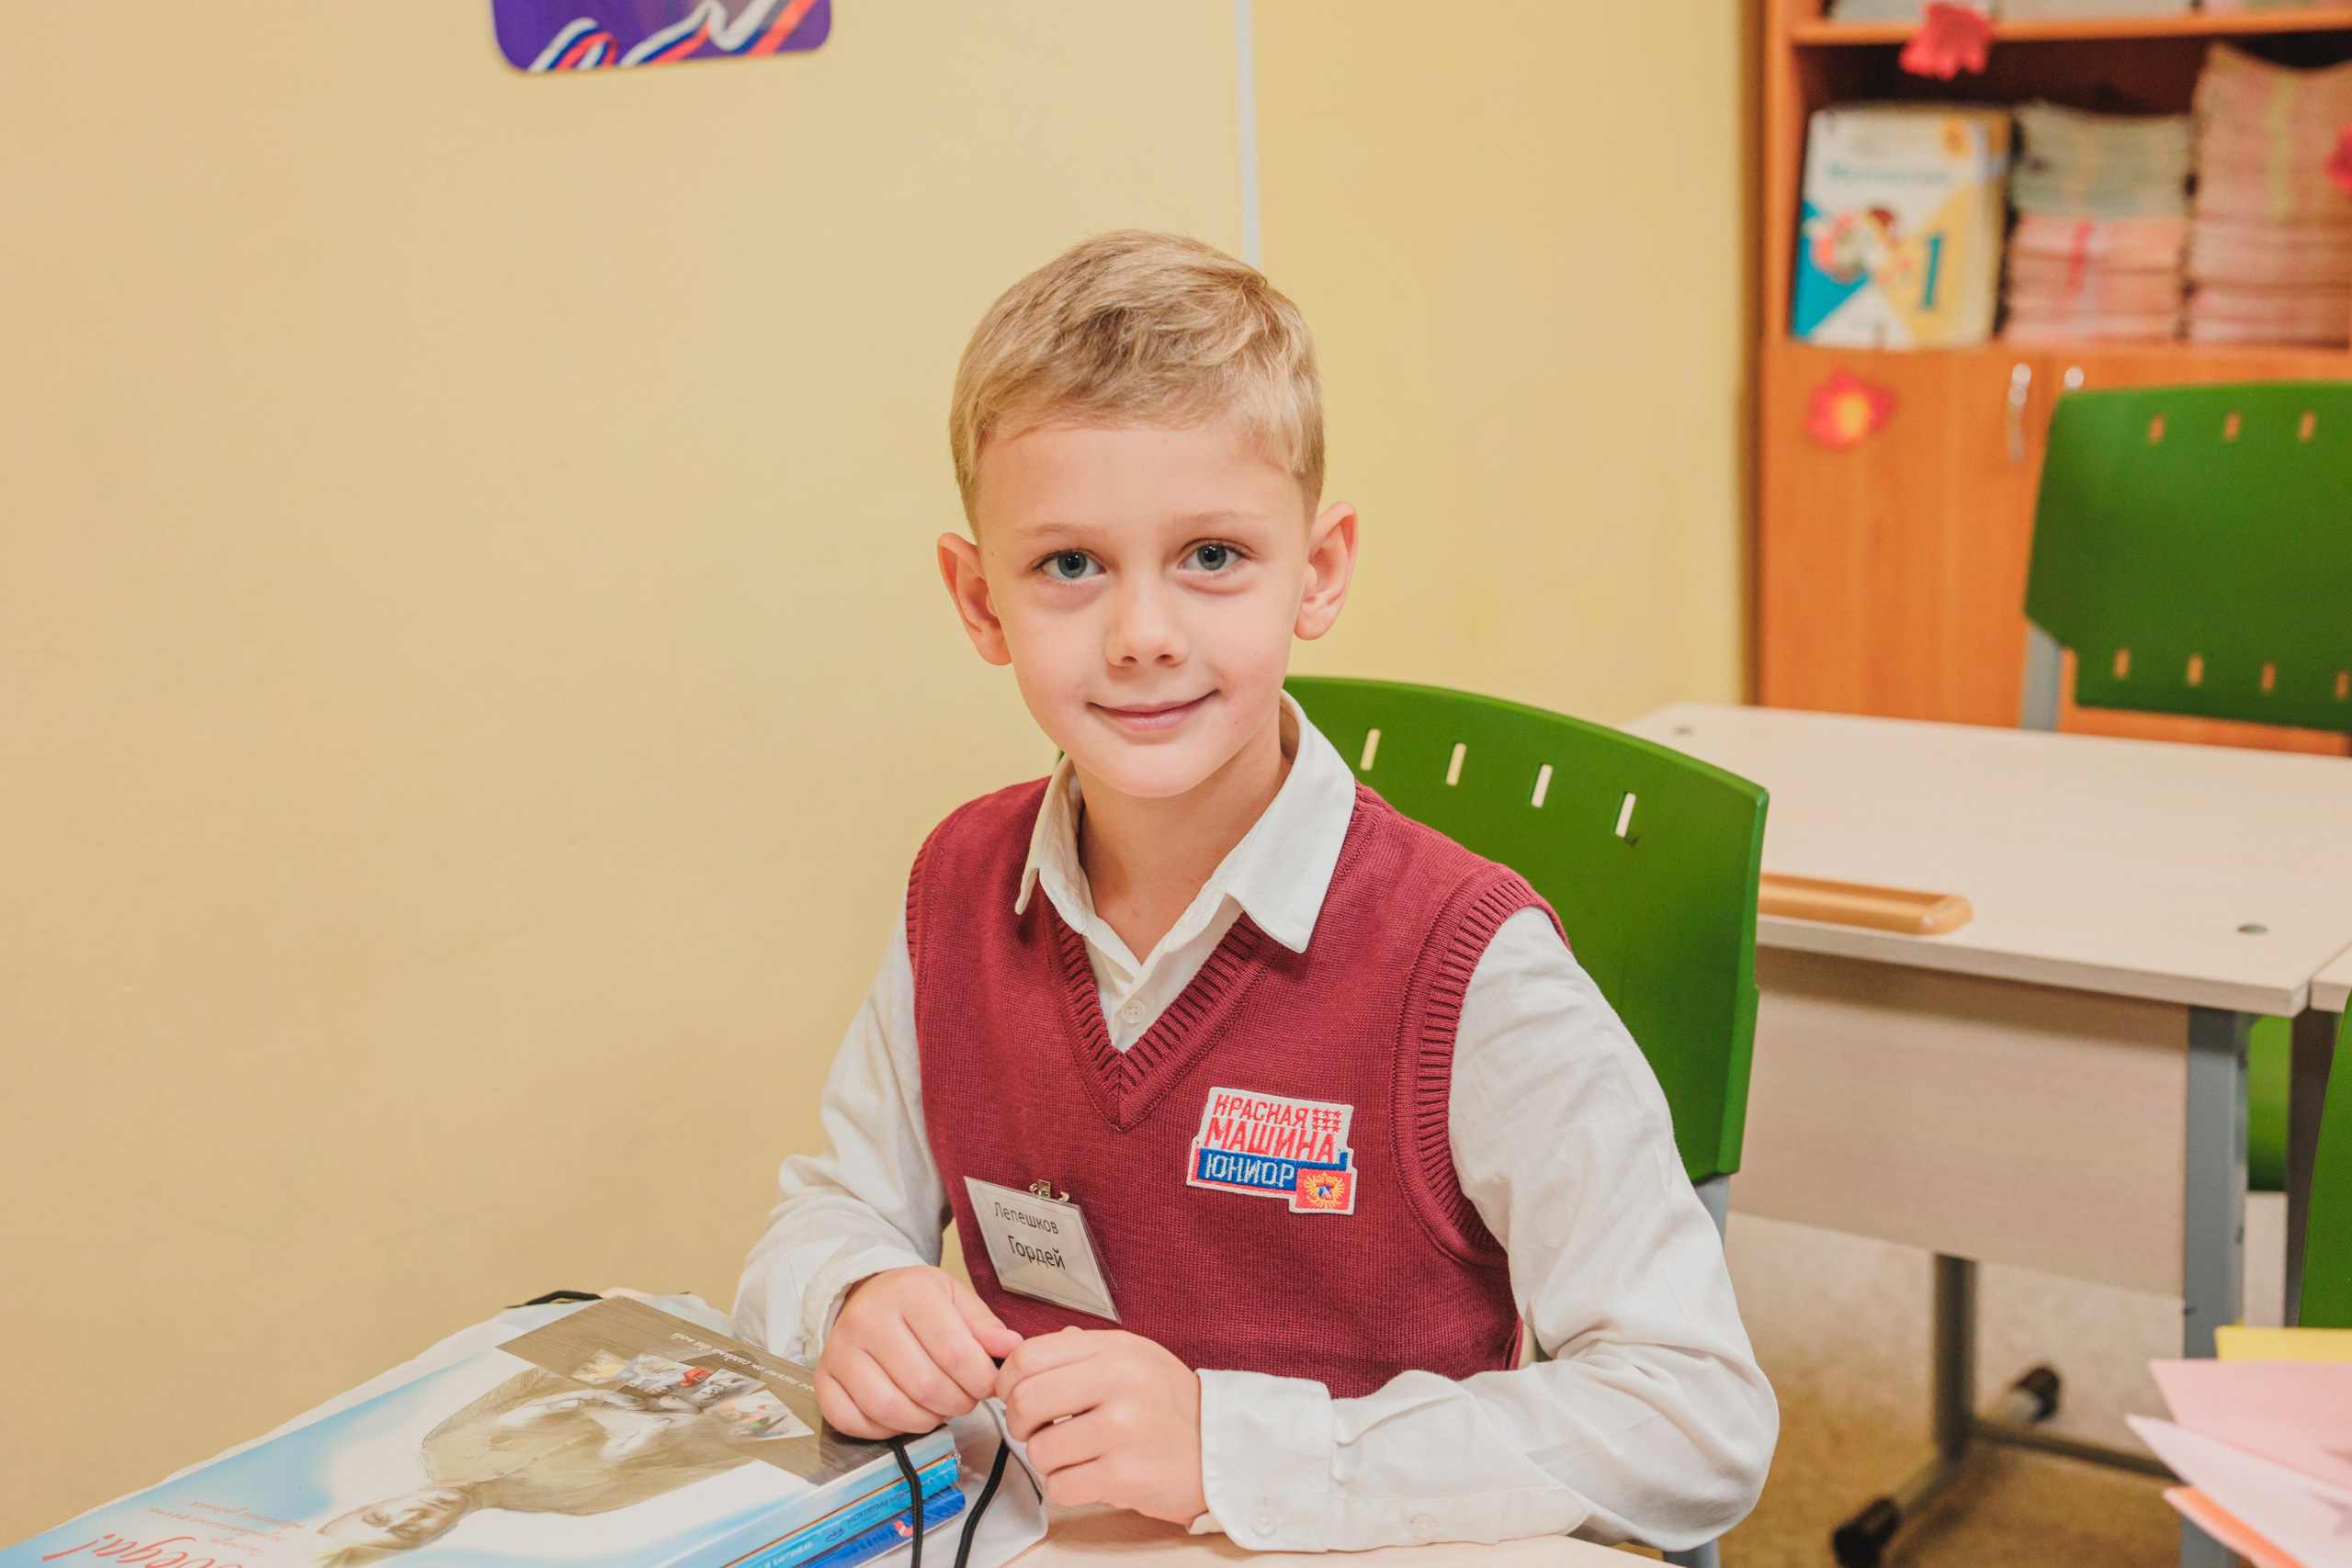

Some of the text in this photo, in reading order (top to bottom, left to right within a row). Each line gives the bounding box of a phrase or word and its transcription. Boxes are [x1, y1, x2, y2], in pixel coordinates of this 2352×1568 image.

[1212, 1093, 1310, 1129] КРАСНАЯ
[1204, 1117, 1336, 1163] МАШИНА
[1204, 1154, 1295, 1188] ЮНИОР
[994, 1201, 1059, 1235] Лепешков
[1007, 1235, 1066, 1270] Гордей
[712, 1347, 752, 1366] солдата
[752, 1362, 766, 1372] от
[764, 1370, 800, 1385] письмо
